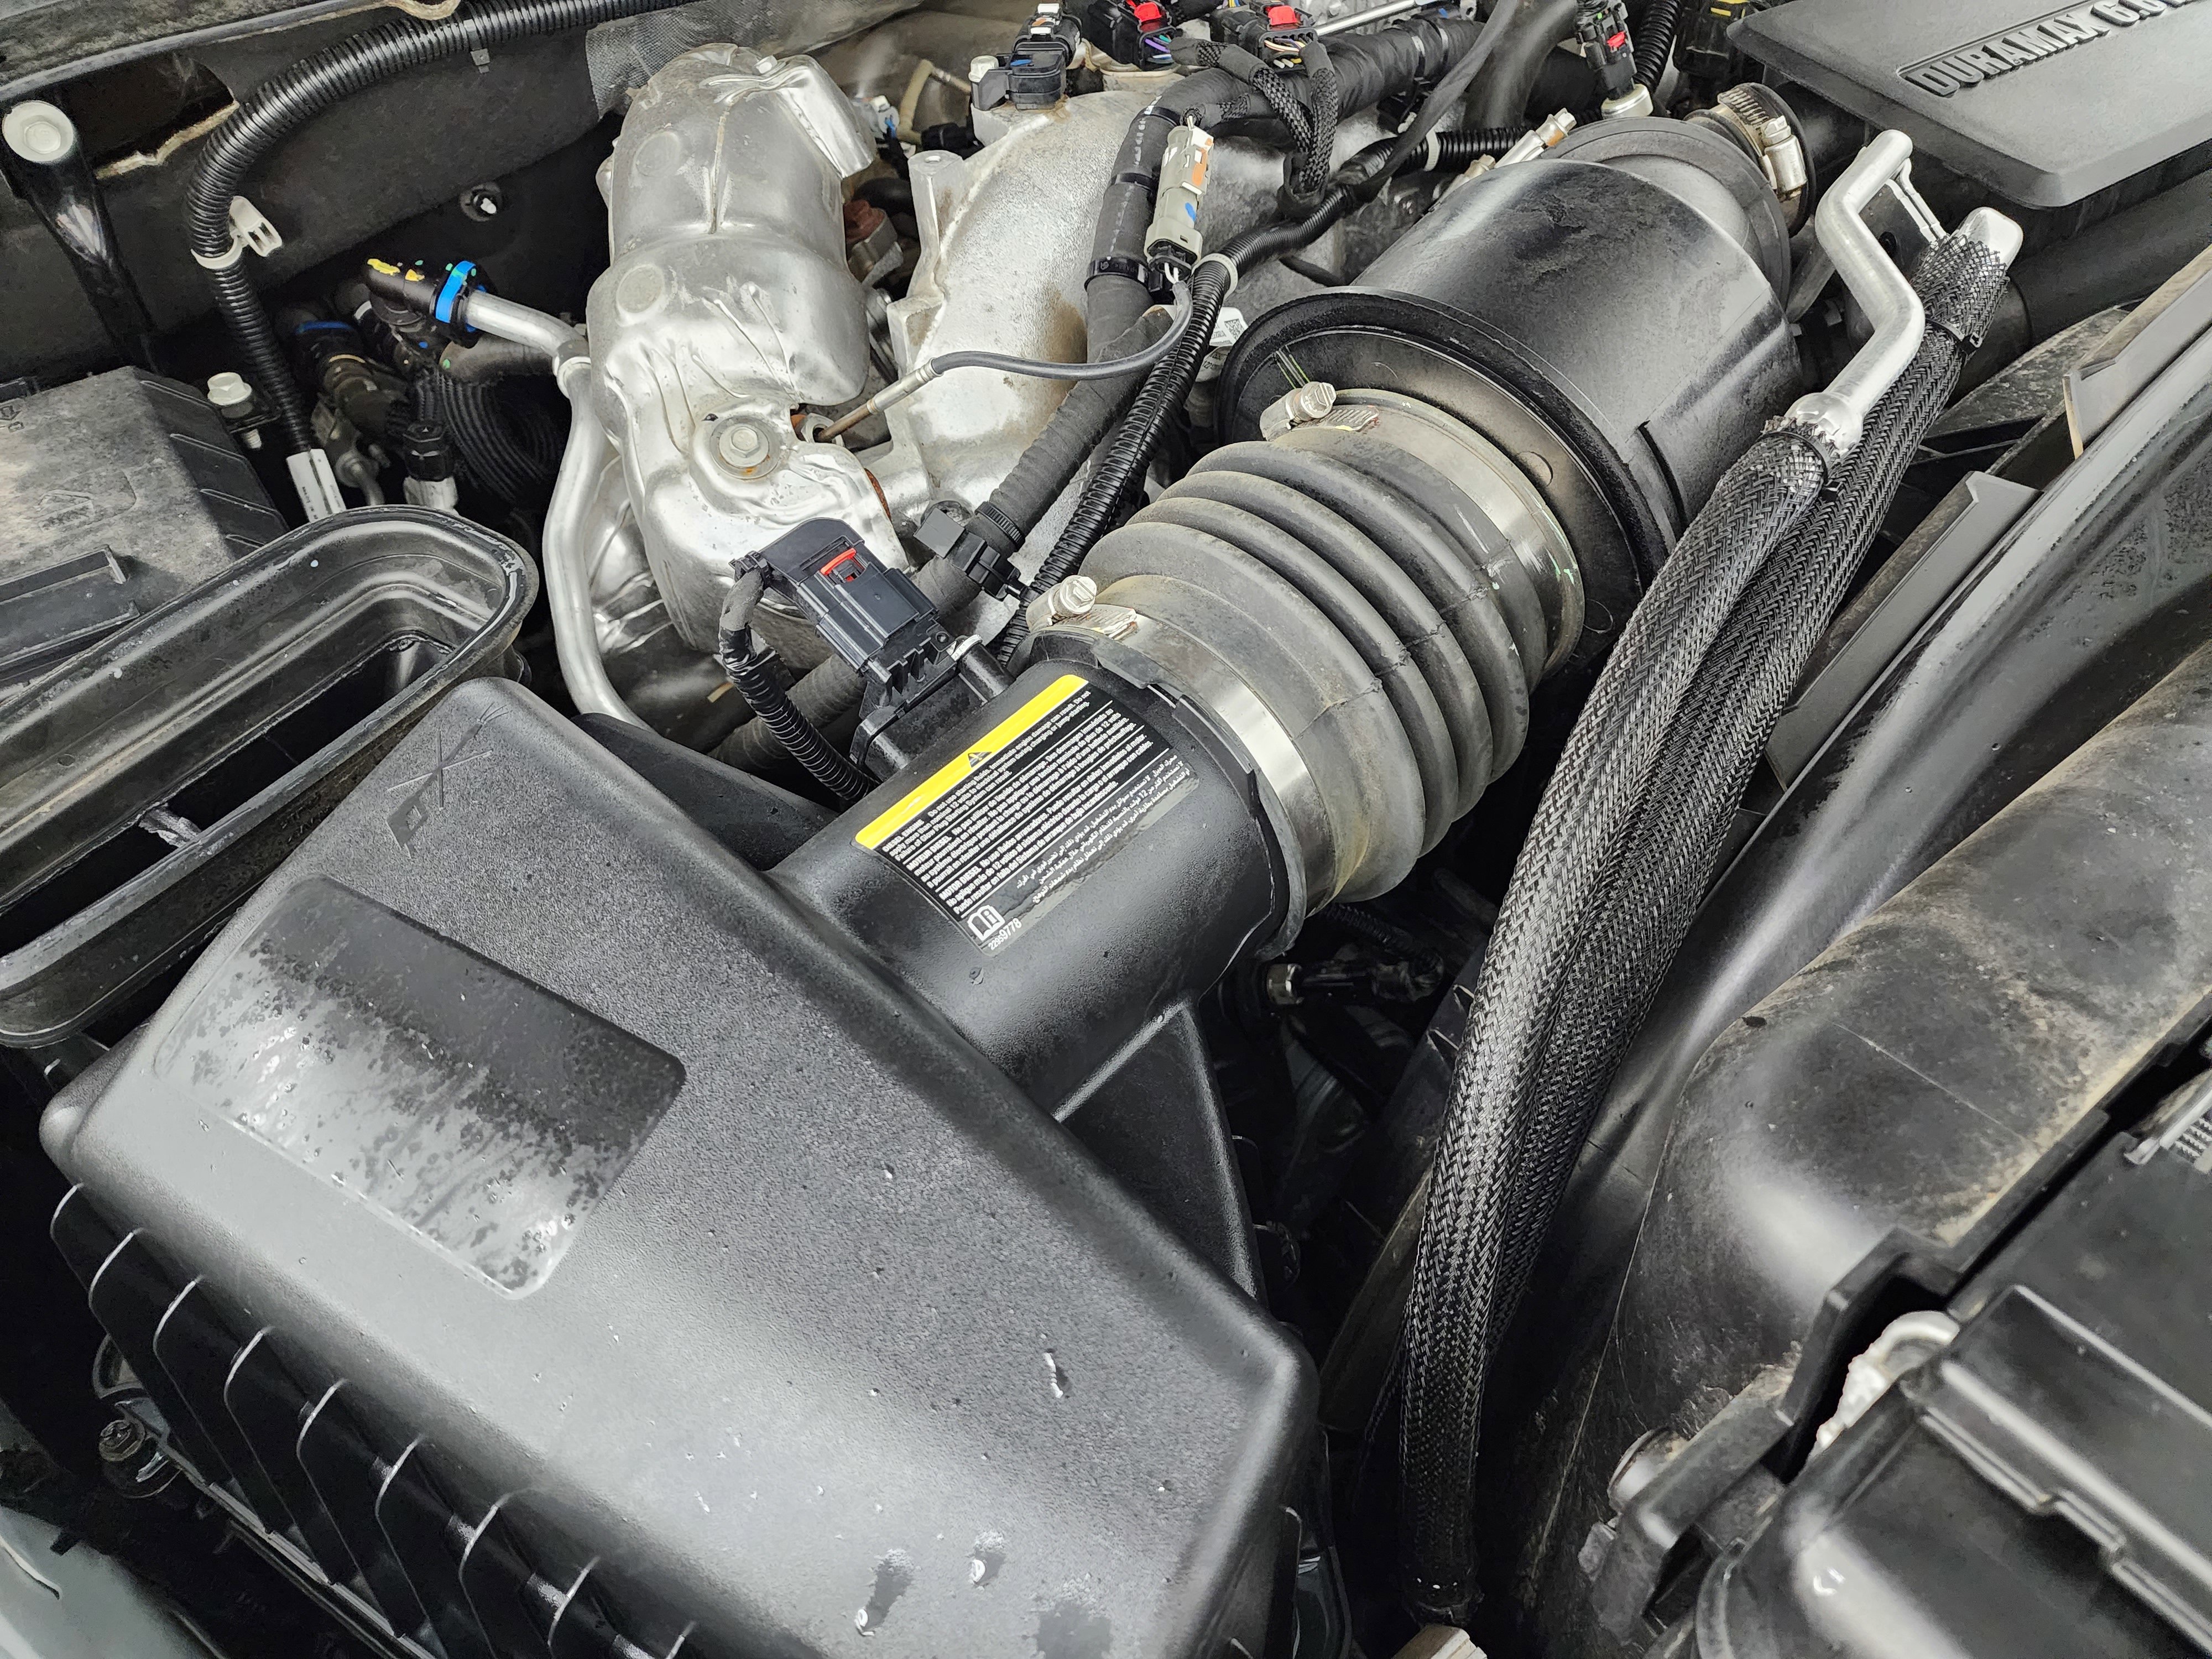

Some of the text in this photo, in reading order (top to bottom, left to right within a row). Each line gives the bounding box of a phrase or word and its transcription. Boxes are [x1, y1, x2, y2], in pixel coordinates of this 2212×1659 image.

[1905, 13, 2110, 98] DURAMAX
[881, 835, 905, 852] DIESEL
[900, 818, 925, 837] ENGINE
[927, 808, 938, 817] Do
[935, 801, 948, 811] not
[945, 794, 957, 804] use
[954, 779, 977, 797] starting
[988, 748, 1017, 770] Immediate
[1014, 735, 1034, 750] engine
[1031, 721, 1052, 738] damage
[1050, 713, 1061, 723] can
[1072, 696, 1083, 705] Do
[1080, 690, 1091, 699] not
[889, 842, 906, 857] apply
[904, 831, 920, 845] more
[916, 822, 933, 834] than
[929, 806, 952, 827] nominal
[949, 800, 959, 809] 12
[956, 791, 972, 804] volts
[974, 769, 999, 790] electrical
[997, 757, 1017, 773] system
[1014, 745, 1033, 760] during
[1029, 729, 1053, 748] charging
[894, 844, 916, 862] Failure
[914, 838, 922, 847] of
[919, 828, 936, 842] Glow
[932, 819, 949, 832] Plug
[944, 804, 969, 822] Starting
[964, 789, 987, 806] System
[984, 781, 997, 792] can
[905, 848, 933, 871] MOTEUR
[928, 834, 952, 853] DIESEL
[951, 826, 963, 836] Ne
[959, 818, 973, 830] pas
[969, 804, 990, 822] utiliser
[987, 799, 997, 807] de
[993, 785, 1014, 802] liquide
[1011, 780, 1021, 789] de
[1044, 751, 1058, 762] Des
[1055, 731, 1084, 754] dommages
[1079, 713, 1107, 734] immédiats
[913, 858, 935, 877] moteur
[932, 836, 963, 862] pourraient
[959, 831, 969, 841] en
[987, 808, 998, 818] Ne
[995, 801, 1008, 813] pas
[1005, 782, 1030, 805] appliquer
[1028, 775, 1041, 786] une
[1037, 761, 1058, 779] tension
[1055, 744, 1080, 764] nominale
[1077, 739, 1087, 748] de
[1083, 731, 1097, 743] plus
[1094, 726, 1104, 734] de
[1100, 720, 1110, 728] 12
[1107, 712, 1121, 723] volts
[920, 873, 931, 883] au
[927, 855, 953, 877] système
[950, 835, 978, 859] électrique
[975, 818, 1000, 839] pendant
[1001, 801, 1022, 818] charge
[1019, 795, 1029, 804] ou
[1087, 732, 1108, 749] batterie
[931, 864, 955, 886] pourrait
[951, 859, 962, 869] en
[958, 844, 980, 863] résulter
[978, 837, 991, 848] une
[987, 816, 1016, 841] défaillance
[1014, 810, 1024, 820] du
[1020, 794, 1044, 814] système
[1041, 789, 1051, 798] de
[1077, 750, 1099, 769] bougies
[1096, 745, 1106, 754] de
[938, 879, 963, 900] MOTOR
[958, 865, 982, 884] DIESEL
[979, 858, 990, 868] No
[987, 850, 1000, 862] use
[997, 837, 1017, 854] fluidos
[1045, 799, 1065, 815] Puede
[1061, 784, 1082, 802] resultar
[1079, 779, 1089, 788] en
[1086, 768, 1103, 782] daños
[1099, 748, 1128, 771] inmediatos
[945, 897, 958, 907] No
[954, 882, 976, 901] aplique
[972, 873, 988, 886] más
[984, 867, 995, 877] de
[991, 860, 1002, 870] 12
[999, 848, 1018, 865] voltios
[1020, 828, 1044, 848] sistema
[1040, 811, 1064, 832] eléctrico
[1061, 797, 1082, 816] durante
[1083, 782, 1100, 797] carga
[1105, 759, 1129, 779] arranque
[1125, 752, 1138, 763] con
[952, 897, 973, 915] Puede
[969, 881, 993, 901] resultar
[989, 875, 1000, 885] en
[995, 867, 1011, 879] falla
[1008, 859, 1019, 871] del
[1015, 844, 1040, 864] Sistema
[1036, 838, 1046, 848] de
[1042, 821, 1067, 842] arranque
[1063, 816, 1074, 825] de
[987, 917, 1022, 951] 22959778
